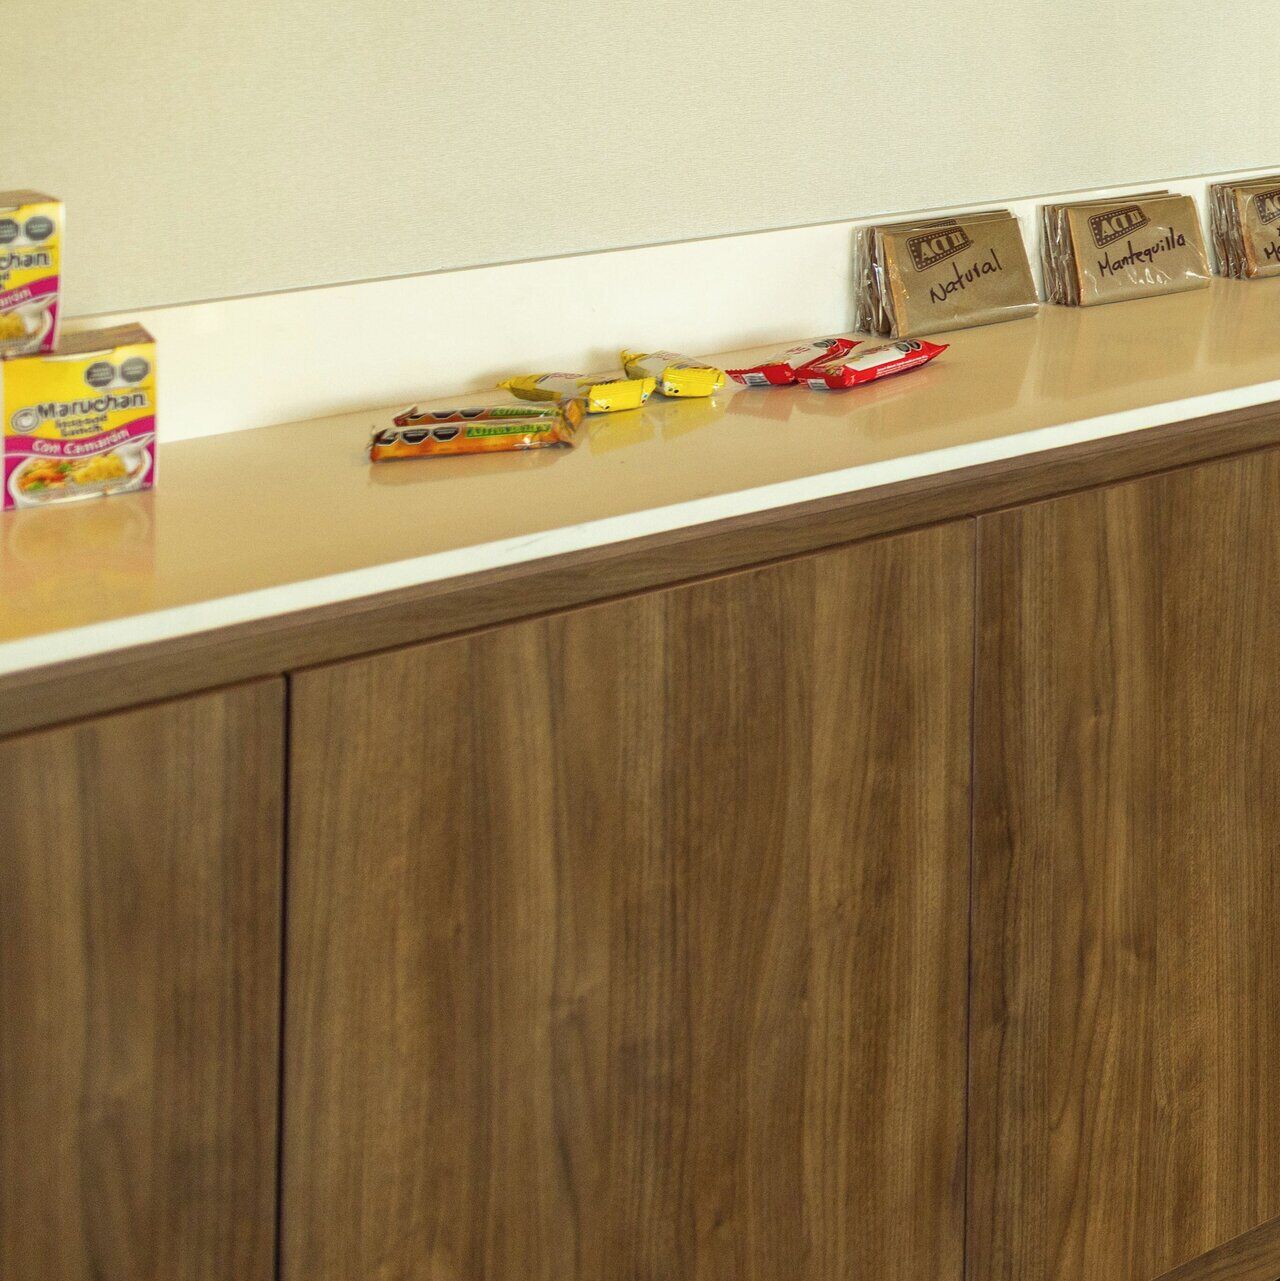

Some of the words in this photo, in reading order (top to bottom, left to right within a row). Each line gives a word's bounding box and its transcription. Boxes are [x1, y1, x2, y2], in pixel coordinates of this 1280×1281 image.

[1101, 212, 1129, 239] ACT
[920, 233, 951, 262] ACT
[1097, 226, 1186, 278] Mantequilla
[929, 248, 1003, 304] Natural
[37, 391, 147, 418] Maruchan
